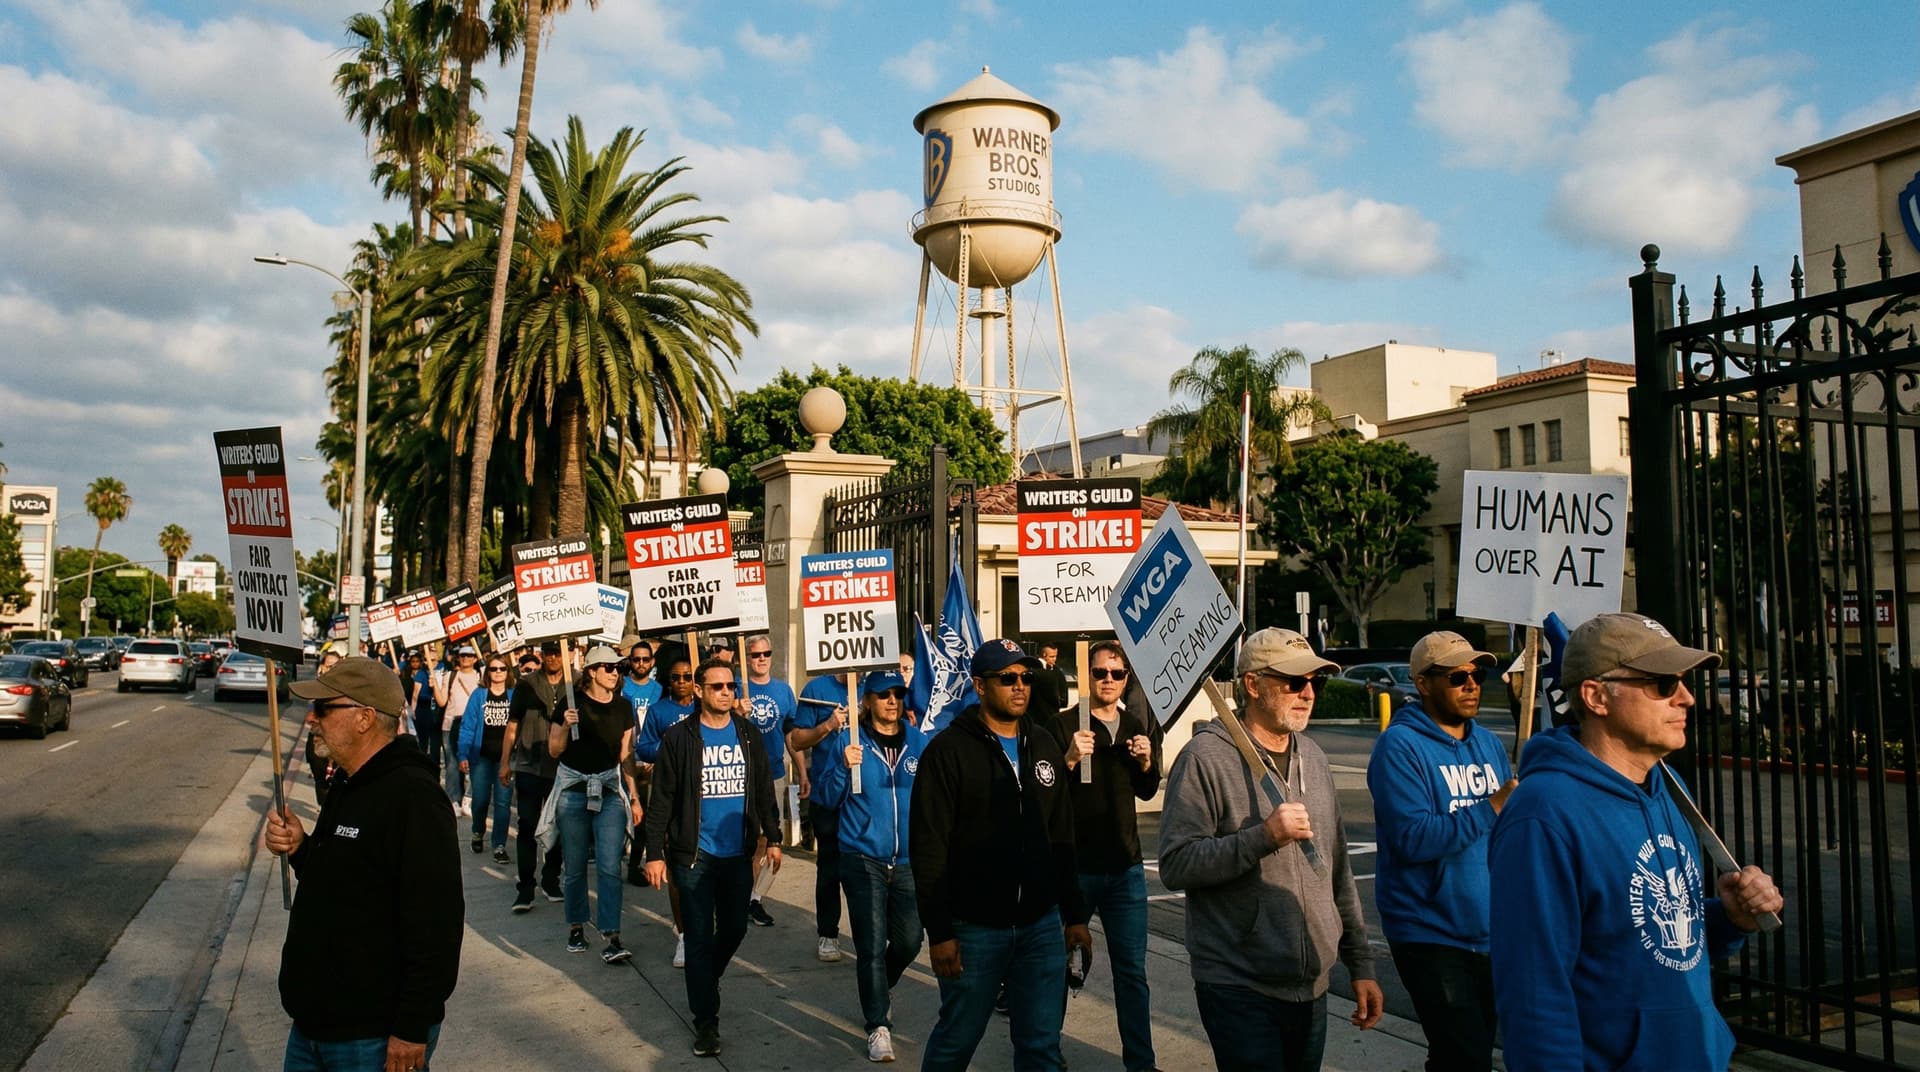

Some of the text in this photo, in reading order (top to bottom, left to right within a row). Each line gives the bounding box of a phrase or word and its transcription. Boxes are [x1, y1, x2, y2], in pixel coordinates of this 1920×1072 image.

[972, 127, 1047, 159] WARNER
[989, 152, 1042, 180] BROS.
[988, 177, 1041, 196] STUDIOS
[220, 443, 280, 465] WRITERS GUILD
[228, 487, 287, 528] STRIKE!
[1024, 488, 1134, 506] WRITERS GUILD
[629, 503, 722, 526] WRITERS GUILD
[1476, 485, 1614, 536] HUMANS
[633, 528, 726, 563] STRIKE!
[1025, 518, 1134, 550] STRIKE!
[249, 544, 272, 569] FAIR
[517, 541, 587, 561] WRITERS GUILD
[739, 549, 760, 560] GUILD
[520, 560, 591, 589] STRIKE!
[667, 568, 700, 583] FAIR
[807, 556, 888, 573] WRITERS GUILD
[1056, 561, 1095, 579] FOR
[1475, 545, 1605, 588] OVER AI
[238, 570, 288, 597] CONTRACT
[649, 580, 721, 600] CONTRACT
[808, 576, 889, 603] STRIKE!
[1124, 550, 1183, 623] WGA
[543, 592, 569, 606] FOR
[599, 592, 624, 608] WGA
[660, 595, 714, 620] NOW
[245, 596, 284, 634] NOW
[526, 603, 594, 624] STREAMING
[823, 610, 876, 635] PENS
[1159, 607, 1186, 646] FOR
[818, 636, 885, 663] DOWN
[1152, 593, 1232, 710] STREAMING
[702, 744, 746, 766] WGA
[701, 764, 746, 782] STRIKE!
[1439, 763, 1501, 797] WGA
